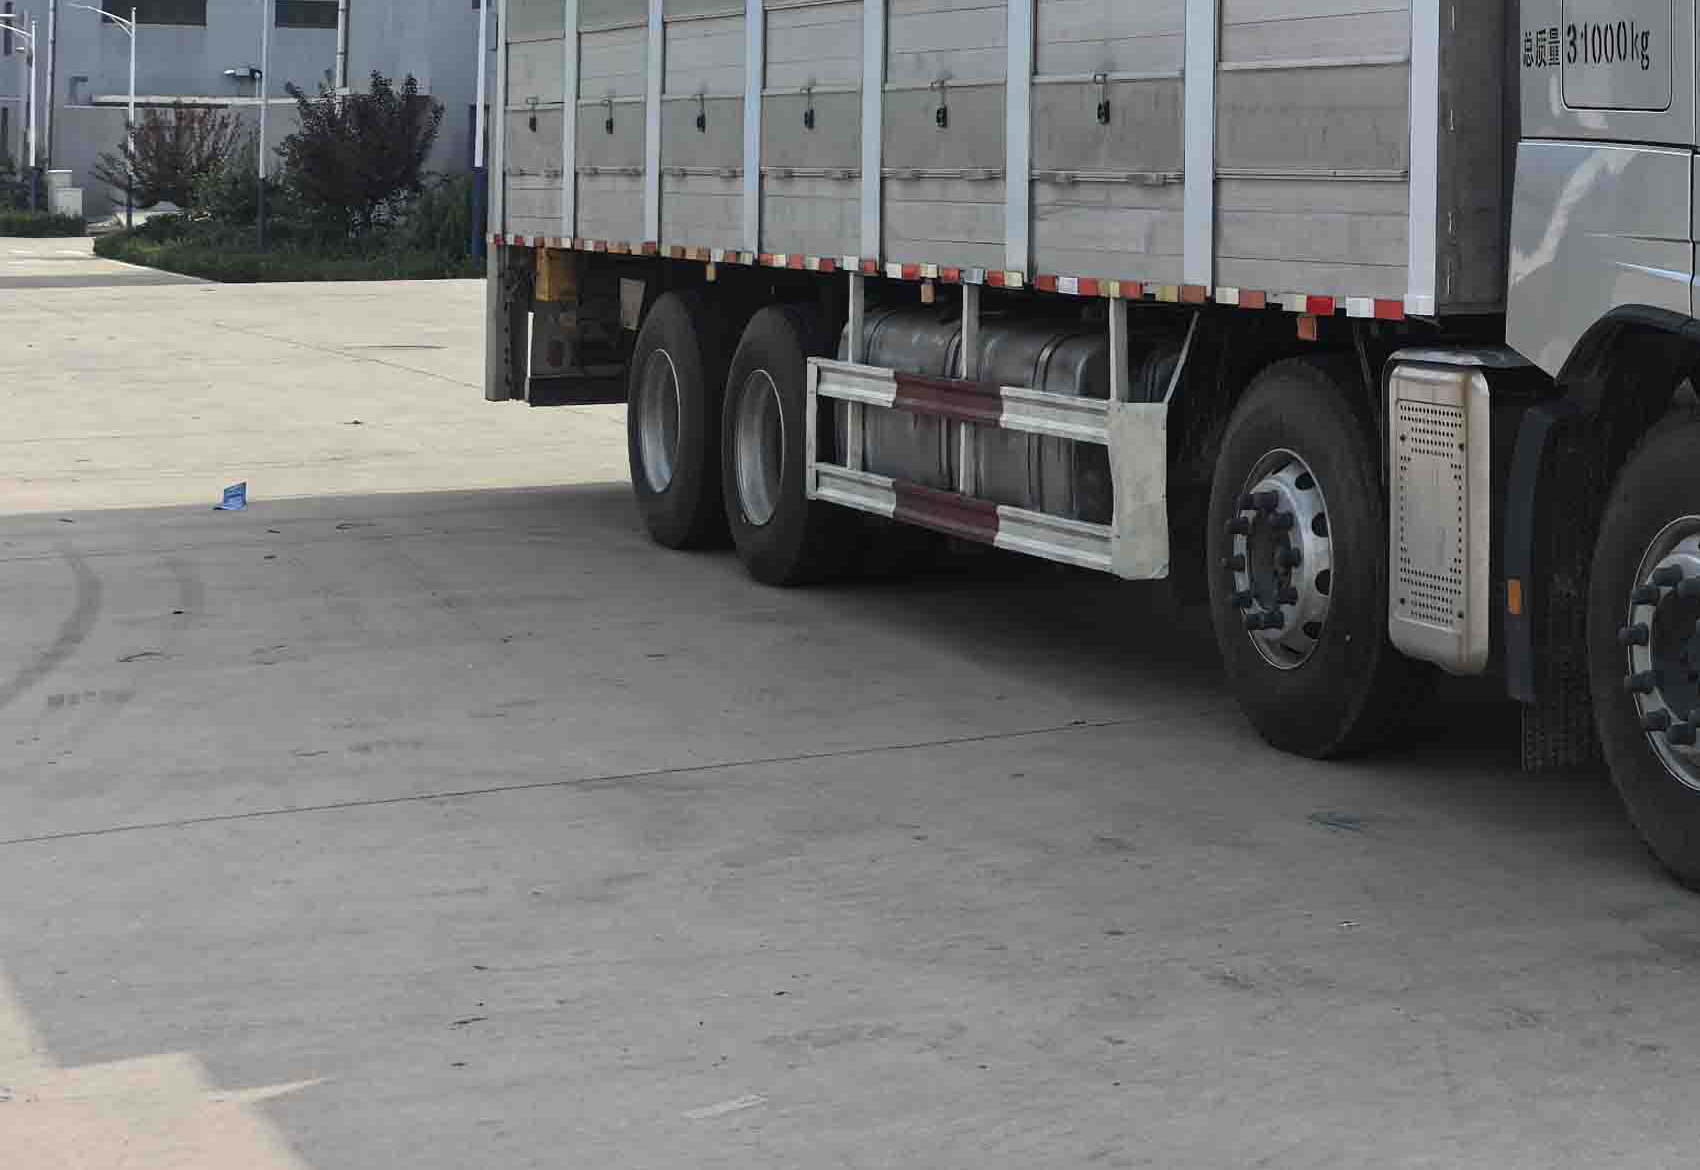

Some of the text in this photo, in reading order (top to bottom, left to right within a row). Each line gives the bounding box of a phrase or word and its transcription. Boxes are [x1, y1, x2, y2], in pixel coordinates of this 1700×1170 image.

[1522, 21, 1651, 71] 总质量 31000kg
